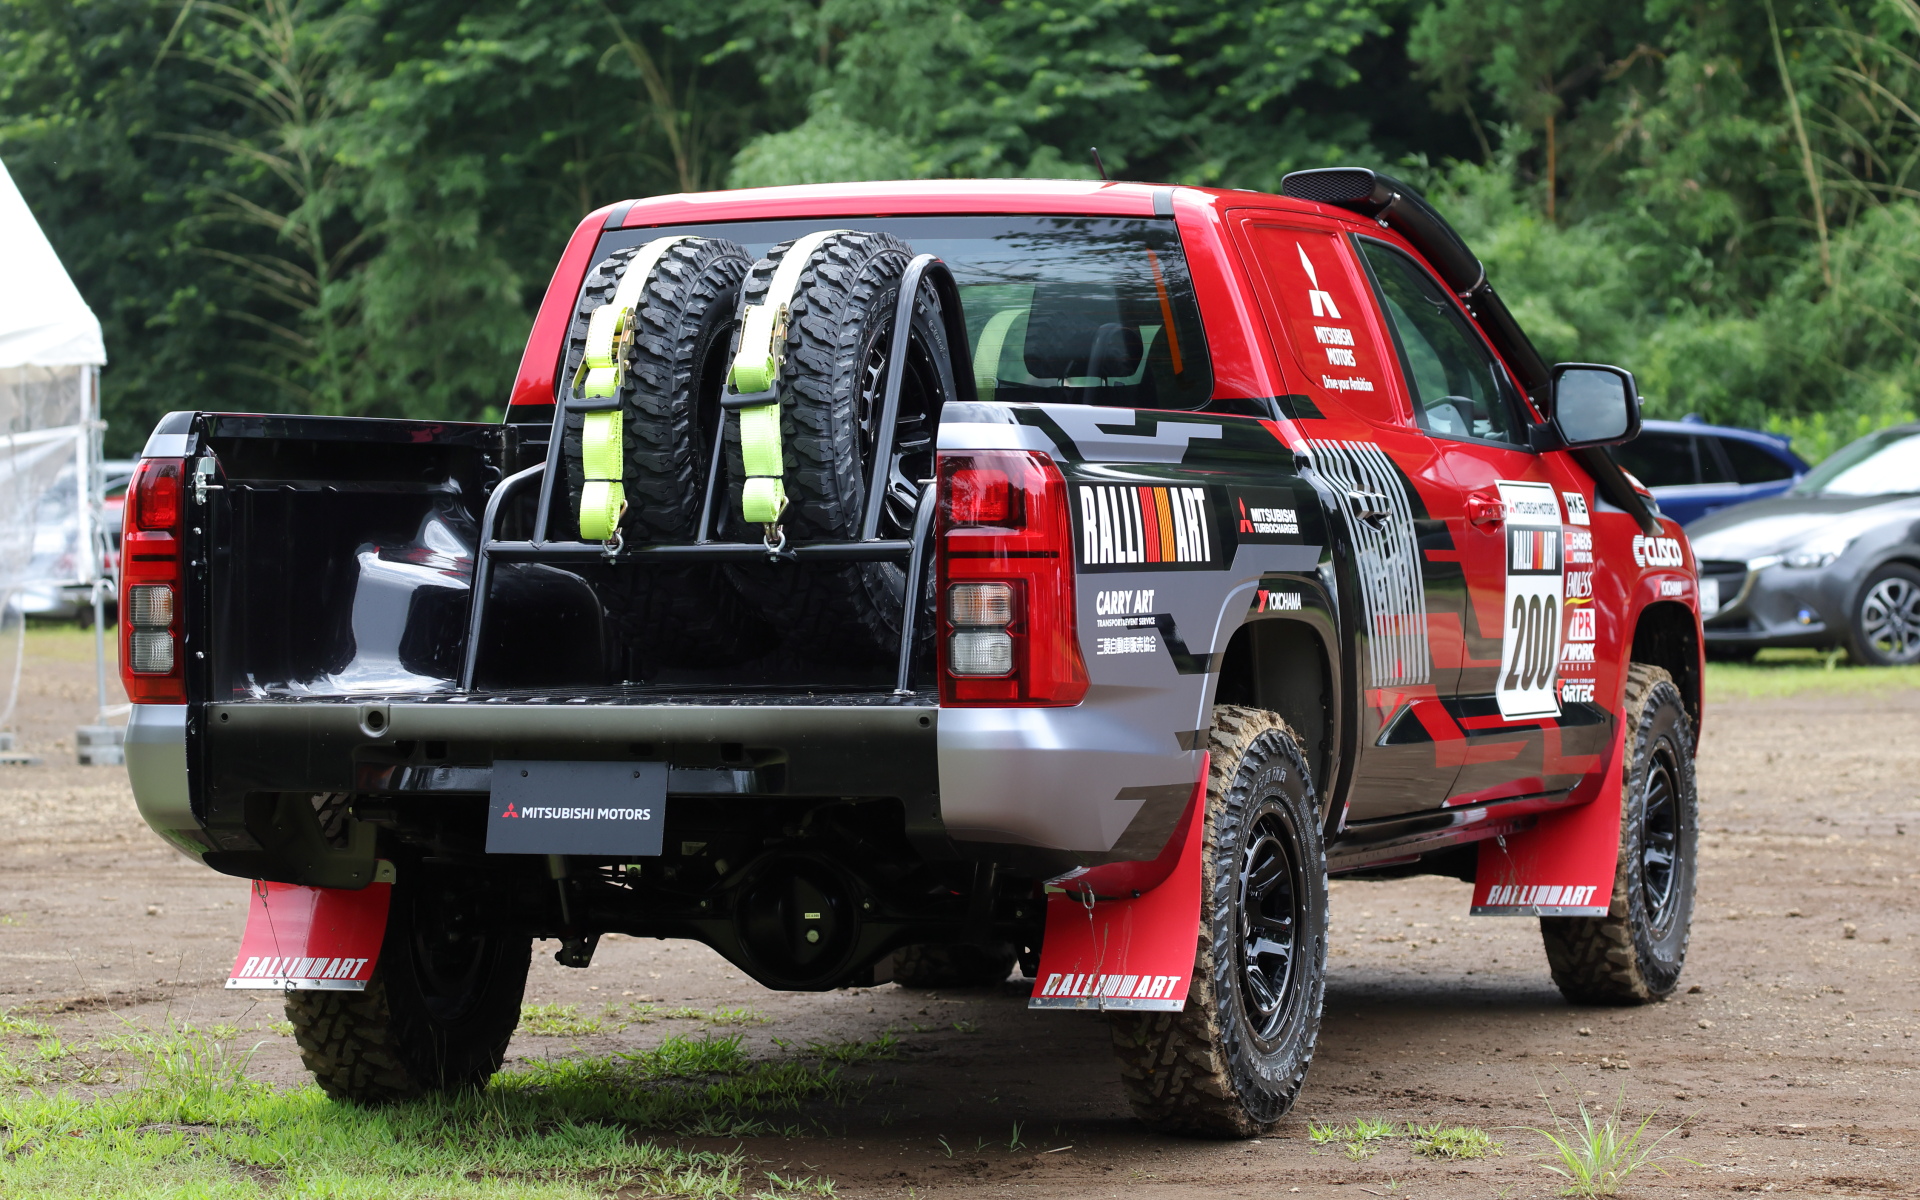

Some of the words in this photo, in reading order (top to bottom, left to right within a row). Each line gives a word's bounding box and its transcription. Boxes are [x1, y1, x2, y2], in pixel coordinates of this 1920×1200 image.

[1313, 325, 1355, 346] MITSUBISHI
[1325, 347, 1357, 367] MOTORS
[1321, 374, 1339, 390] Drive
[1565, 495, 1587, 514] HKS
[1079, 486, 1211, 564] RALLIART
[1250, 508, 1298, 523] MITSUBISHI
[1253, 523, 1300, 534] TURBOCHARGER
[1513, 530, 1557, 570] RALLIART
[1572, 532, 1593, 551] ENEOS
[1644, 536, 1683, 567] CUSCO
[1566, 571, 1593, 598] ENDLESS
[1096, 590, 1133, 615] CARRY
[1133, 589, 1155, 613] ART
[1268, 592, 1302, 610] YOKOHAMA
[1138, 616, 1156, 626] SERVICE
[1573, 611, 1593, 637] TPR
[1504, 594, 1557, 691] 200
[1567, 643, 1596, 660] WORK
[522, 806, 594, 820] MITSUBISHI
[597, 808, 651, 821] MOTORS
[238, 956, 369, 979] RALLIART
